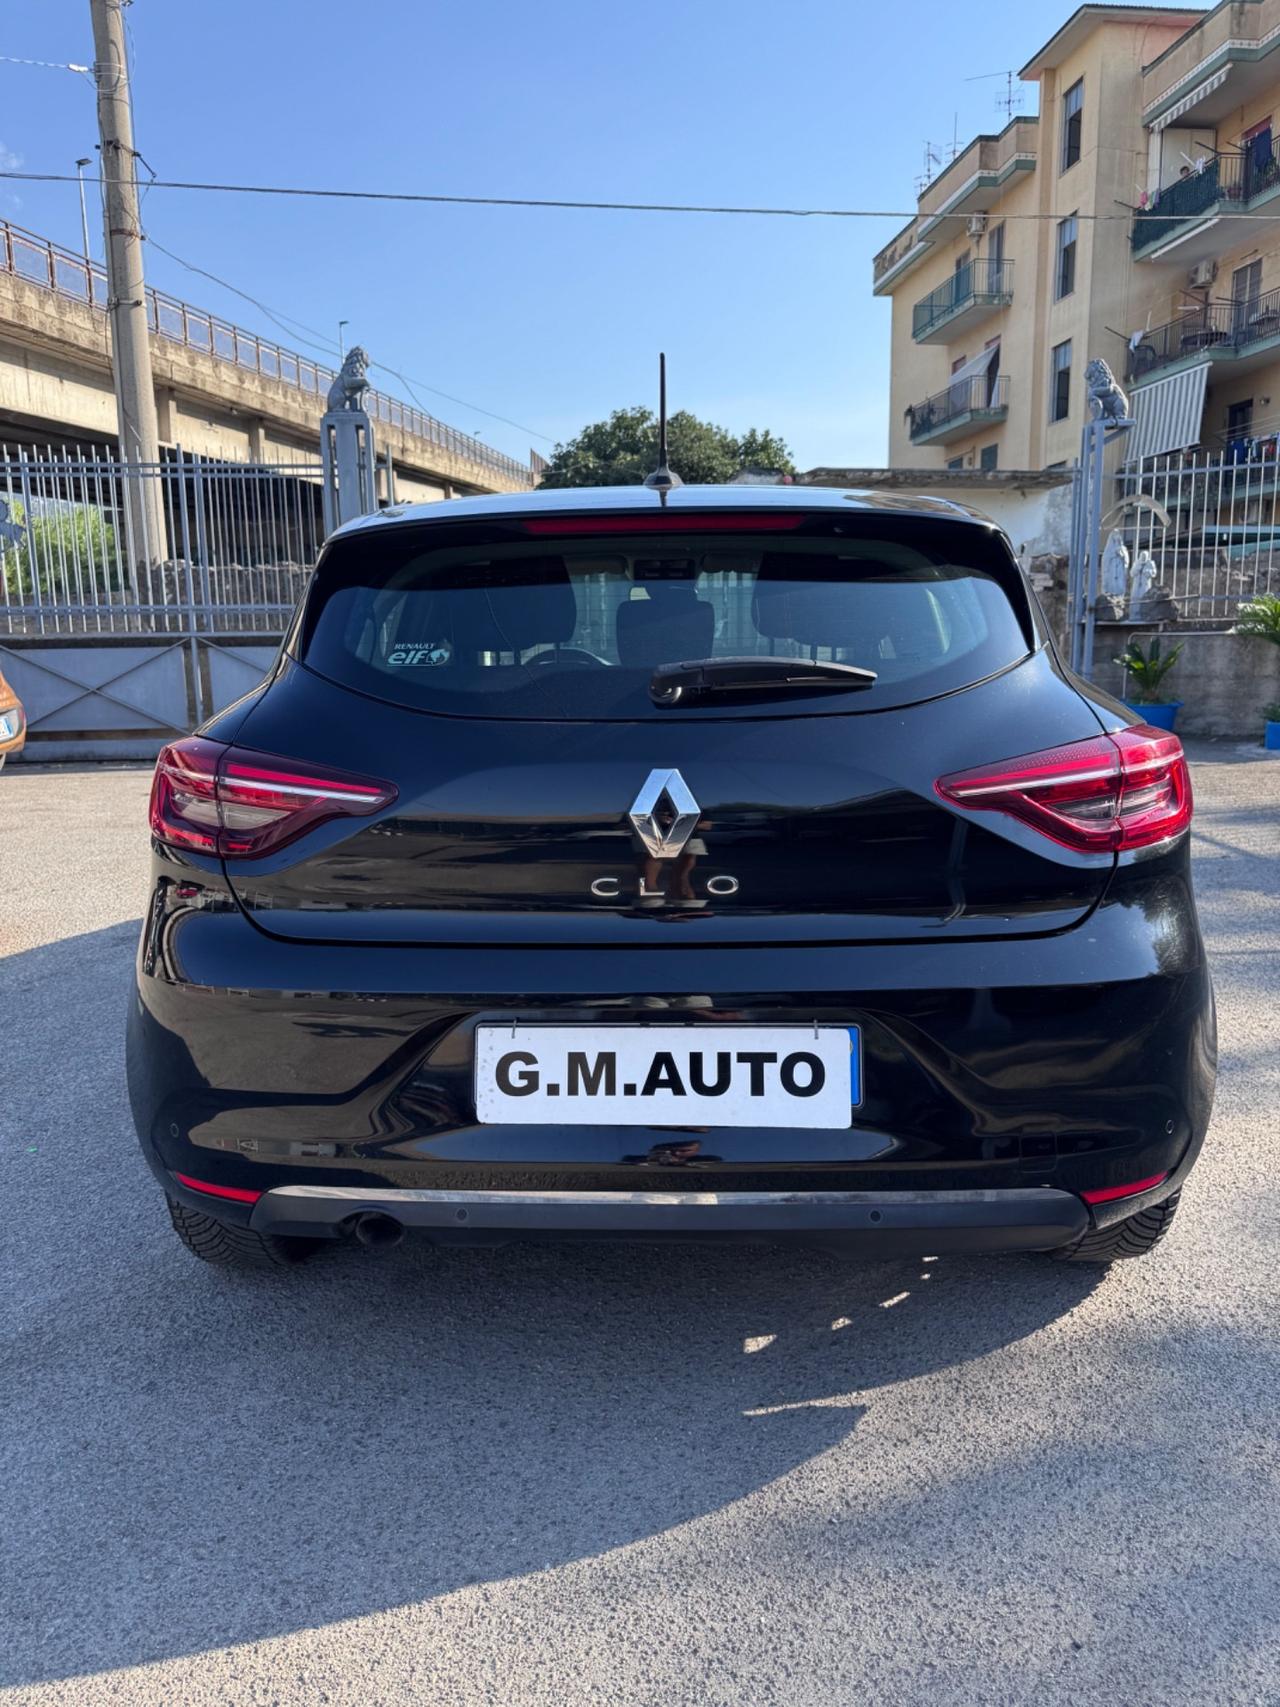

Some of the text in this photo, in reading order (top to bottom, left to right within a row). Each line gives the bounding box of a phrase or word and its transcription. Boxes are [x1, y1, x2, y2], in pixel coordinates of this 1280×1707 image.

[387, 650, 429, 664] elf
[590, 875, 739, 897] CLO
[495, 1051, 826, 1097] G.M.AUTO
